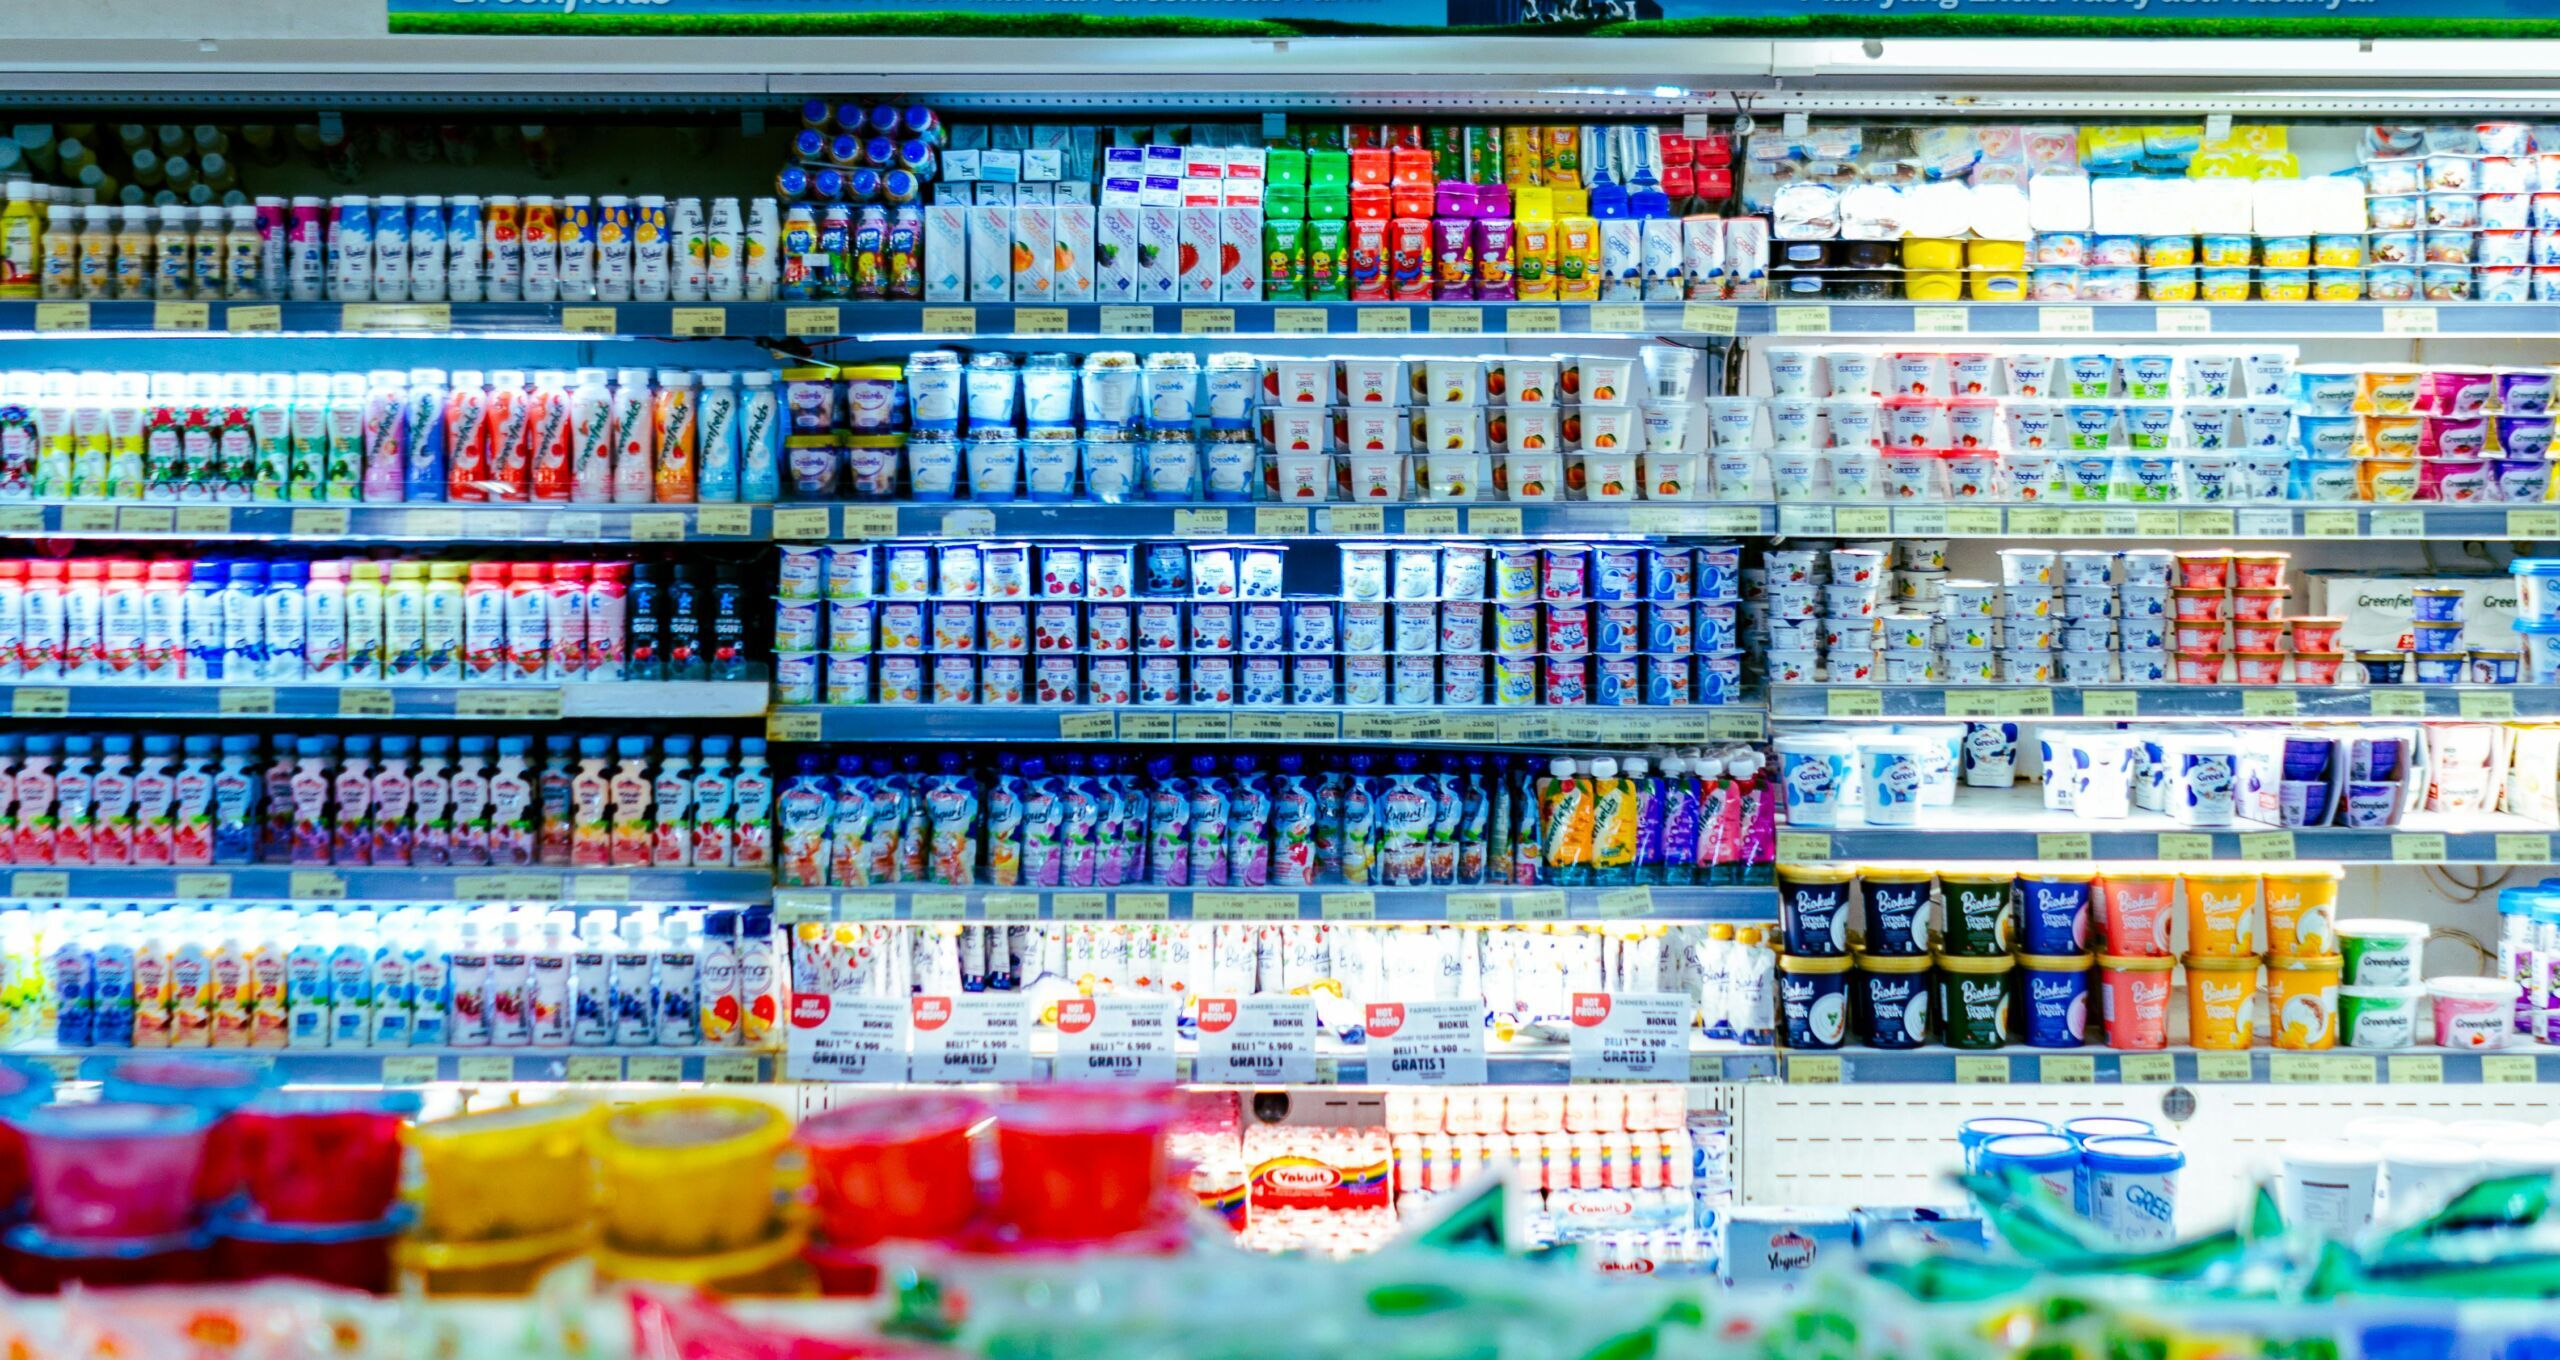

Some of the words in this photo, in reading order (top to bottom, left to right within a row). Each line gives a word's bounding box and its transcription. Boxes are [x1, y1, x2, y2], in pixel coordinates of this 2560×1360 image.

[2015, 370, 2044, 382] Yoghurt
[2075, 370, 2104, 382] Yoghurt
[2137, 370, 2165, 382] Yoghurt
[2200, 370, 2229, 382] Yoghurt
[2077, 421, 2106, 433] Yoghurt
[1032, 455, 1062, 464] CreaMix
[1090, 456, 1117, 465] CreaMix
[1155, 455, 1185, 464] CreaMix
[1211, 455, 1241, 464] CreaMix
[2077, 472, 2106, 483] Yoghurt
[2138, 472, 2166, 483] Yoghurt
[2359, 595, 2412, 608] Greenfiel
[1975, 737, 1999, 747] Greek
[1800, 771, 1827, 781] Greek
[1891, 771, 1916, 780] Greek
[2198, 771, 2225, 782] Greek
[1384, 802, 1427, 820] Yogurt!
[1797, 890, 1835, 913] Biokul
[1877, 890, 1916, 913] Biokul
[1961, 892, 2000, 914] Biokul
[2038, 889, 2078, 910] Biokul
[2118, 890, 2157, 912] Biokul
[2202, 889, 2241, 912] Biokul
[2364, 957, 2410, 968] Greenfields
[1782, 979, 1814, 1000] Biokul
[1870, 979, 1909, 1000] Biokul
[1961, 981, 2000, 1003] Biokul
[2032, 978, 2071, 999] Biokul
[2132, 981, 2167, 1002] Biokul
[2202, 981, 2240, 1002] Biokul
[802, 1000, 819, 1008] HOT
[923, 1001, 940, 1009] HOT
[1067, 1003, 1084, 1012] HOT
[1208, 1003, 1225, 1012] HOT
[1582, 997, 1599, 1007] HOT
[794, 1008, 825, 1019] PROMO
[916, 1010, 947, 1020] PROMO
[1376, 1008, 1392, 1017] HOT
[1409, 1006, 1441, 1014] FARMERS
[1576, 1007, 1606, 1018] PROMO
[988, 1019, 1017, 1027] BIOKUL
[1060, 1013, 1090, 1023] PROMO
[1132, 1019, 1162, 1027] BIOKUL
[1201, 1012, 1231, 1023] PROMO
[1273, 1019, 1303, 1027] BIOKUL
[1369, 1017, 1399, 1028] PROMO
[1647, 1017, 1677, 1026] BIOKUL
[2362, 1017, 2407, 1028] Greenfields
[863, 1020, 893, 1029] BIOKUL
[1438, 1021, 1469, 1030] BIOKUL
[2456, 1019, 2502, 1030] Greenfields
[813, 1053, 856, 1065] GRATIS
[945, 1054, 987, 1065] GRATIS
[1089, 1057, 1132, 1067] GRATIS
[1230, 1057, 1273, 1067] GRATIS
[1603, 1050, 1647, 1063] GRATIS
[1392, 1058, 1436, 1071] GRATIS
[1279, 1171, 1326, 1183] Yakult
[1579, 1203, 1619, 1213] Yakult
[1597, 1261, 1641, 1271] Yakult
